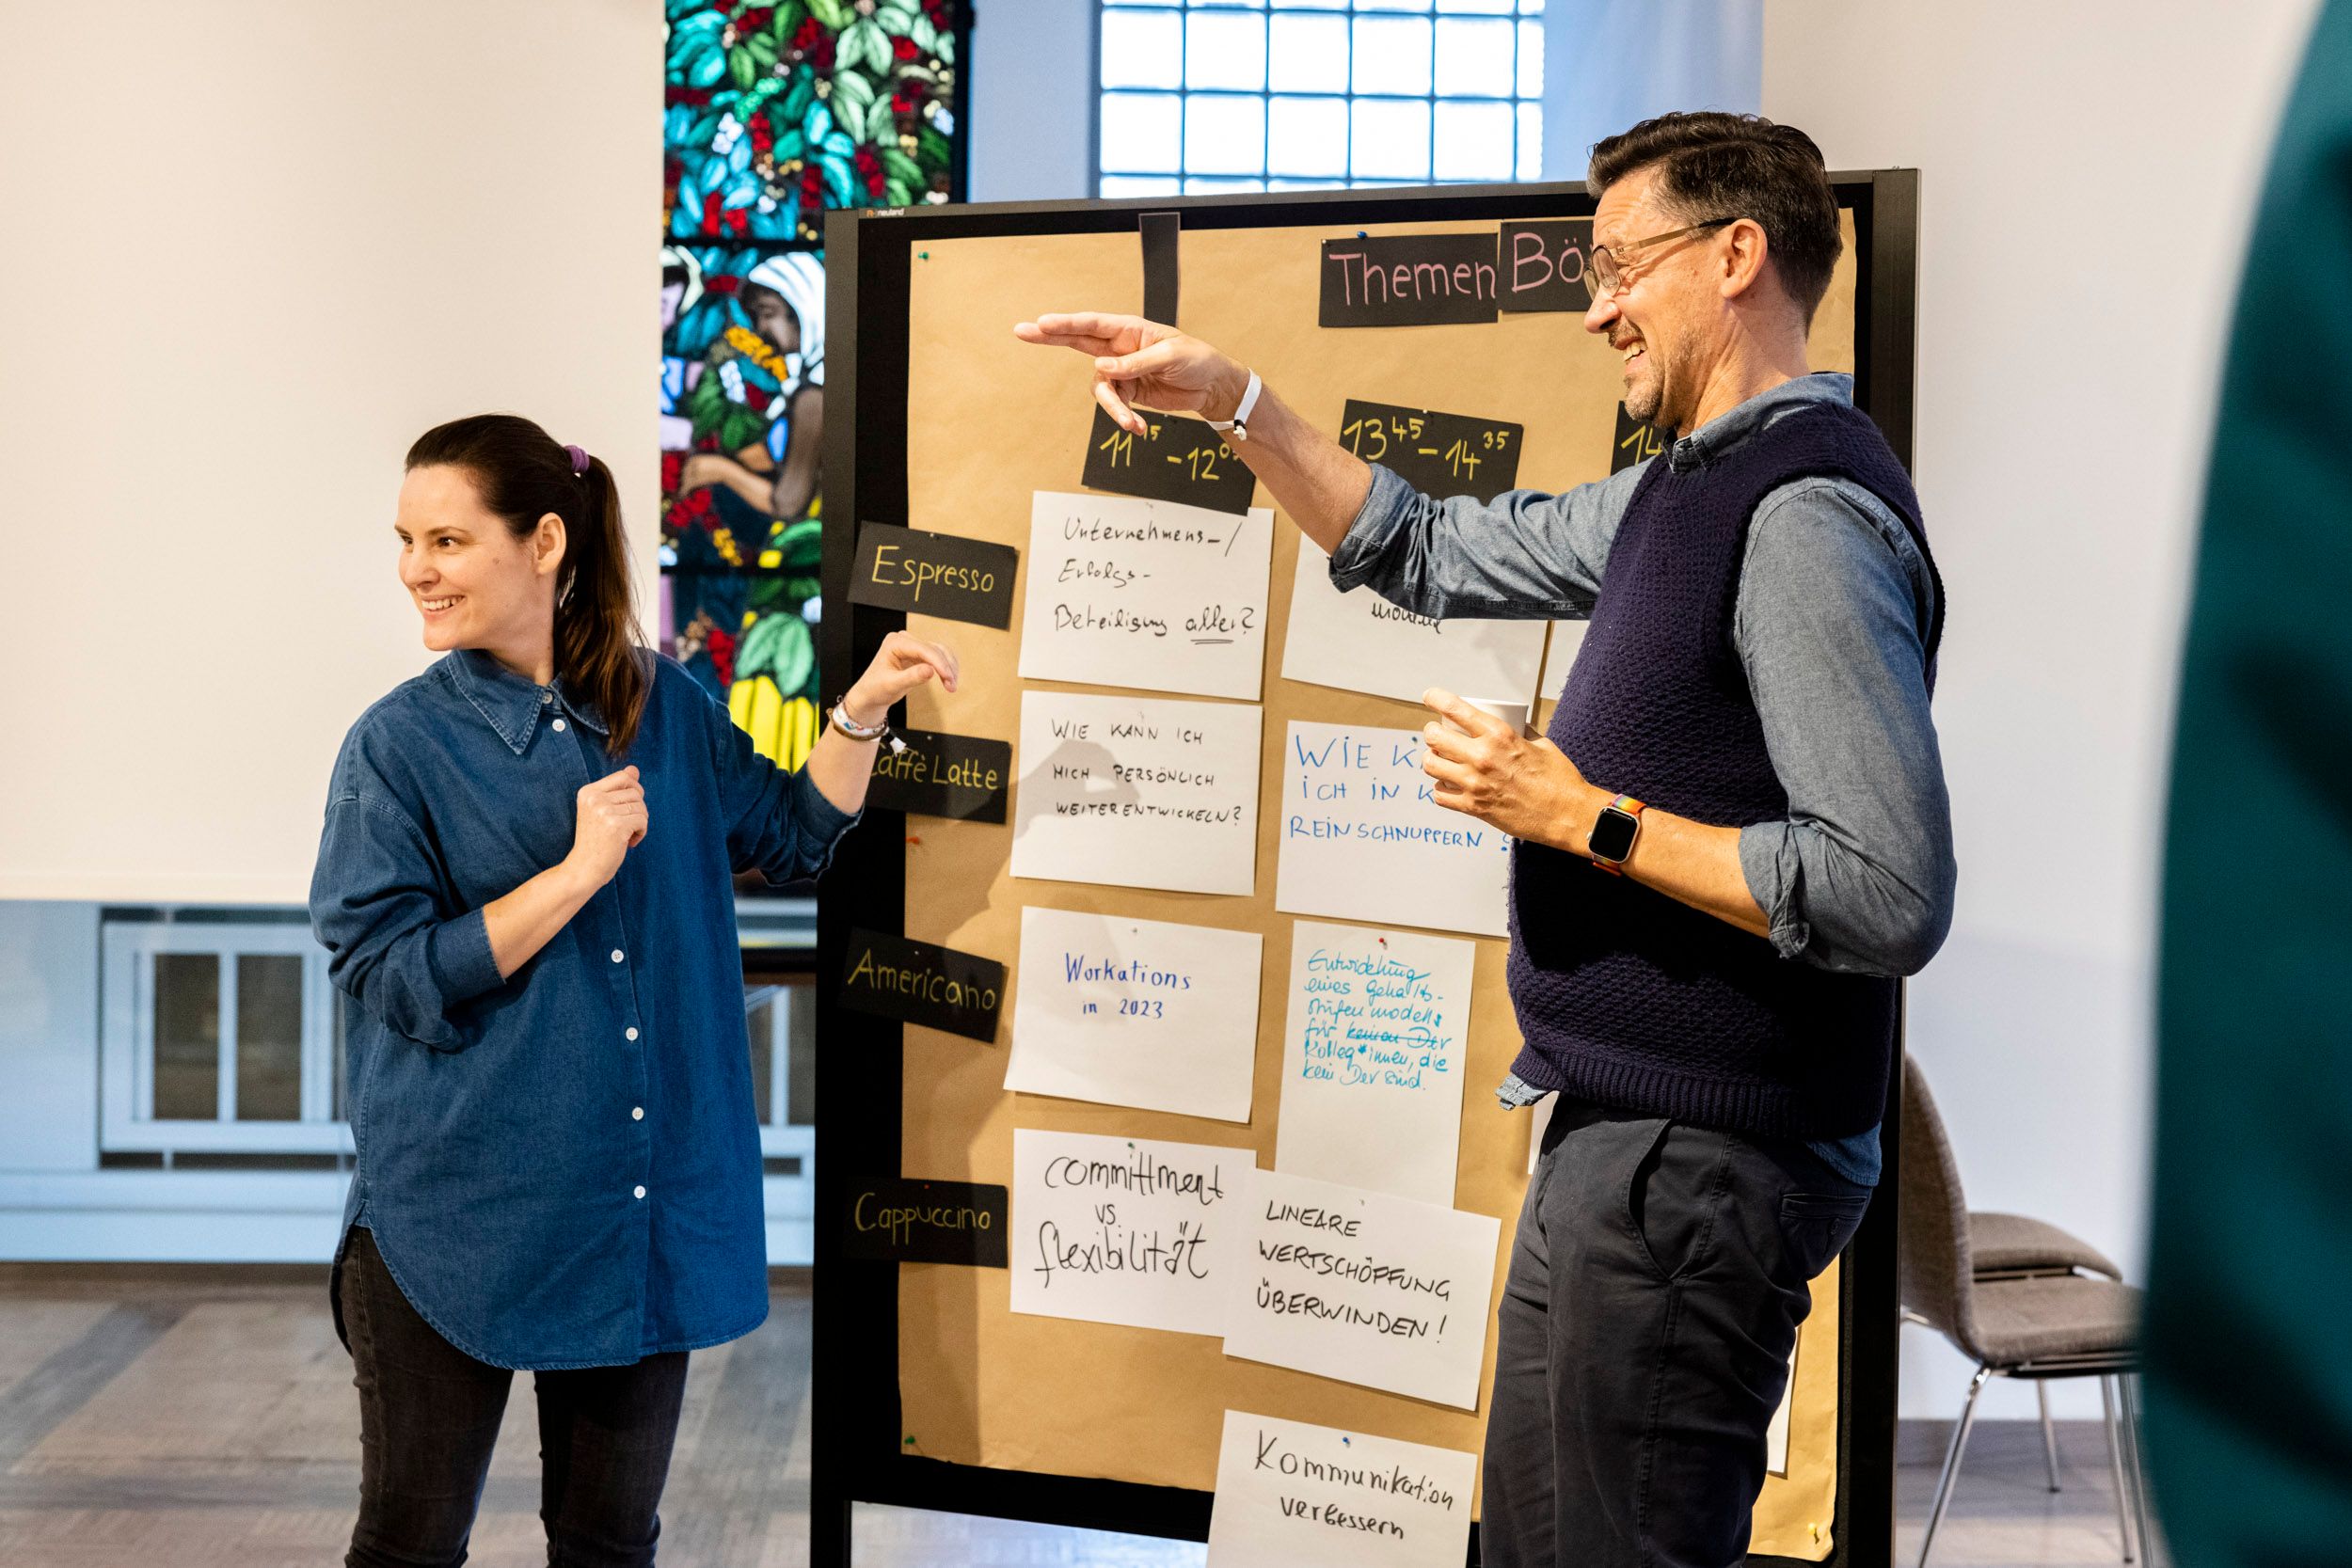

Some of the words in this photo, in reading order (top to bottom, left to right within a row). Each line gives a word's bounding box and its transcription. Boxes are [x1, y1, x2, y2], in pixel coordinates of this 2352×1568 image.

[1328, 252, 1497, 307] Themen
[1511, 231, 1593, 293] Bö
[870, 545, 994, 601] Espresso
[1055, 604, 1168, 637] Beteiligung
[1051, 719, 1089, 740] WIE
[1110, 723, 1159, 741] KANN
[1176, 727, 1202, 745] ICH
[931, 754, 1000, 791] Latte
[1113, 764, 1215, 786] PERSÖNLICH
[847, 947, 996, 1011] Americano
[1065, 952, 1192, 990] Workations
[1082, 1000, 1098, 1015] in
[1120, 998, 1164, 1019] 2023
[1305, 1018, 1338, 1040] für
[1419, 1051, 1449, 1072] die
[854, 1192, 992, 1246] Cappuccino
[1265, 1199, 1362, 1237] LINEARE
[1258, 1239, 1451, 1303] WERTSCHÖPFUNG
[1254, 1429, 1454, 1511] Kommunikation
